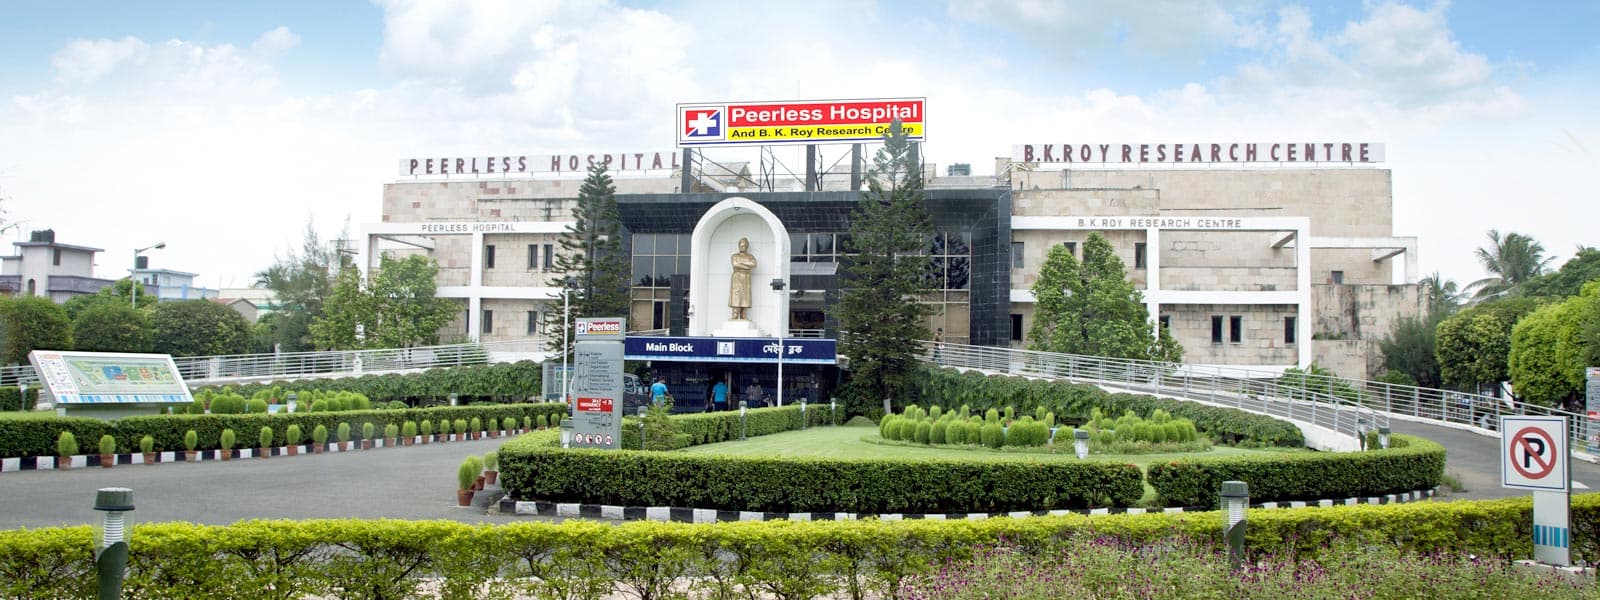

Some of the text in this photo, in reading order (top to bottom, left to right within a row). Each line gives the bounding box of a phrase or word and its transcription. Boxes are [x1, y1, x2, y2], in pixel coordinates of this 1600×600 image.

[731, 103, 917, 122] Peerless Hospital
[731, 125, 914, 138] And B. K. Roy Research Cere
[1121, 143, 1257, 162] RESEARCH
[1271, 142, 1370, 162] CENTRE
[410, 152, 681, 175] PEERLESS HOSPITAL
[421, 223, 516, 232] PEERLESS HOSPITAL
[1130, 218, 1190, 228] RESEARCH
[1197, 219, 1242, 228] CENTRE
[587, 322, 620, 331] Peerless
[645, 342, 694, 352] Main Block
